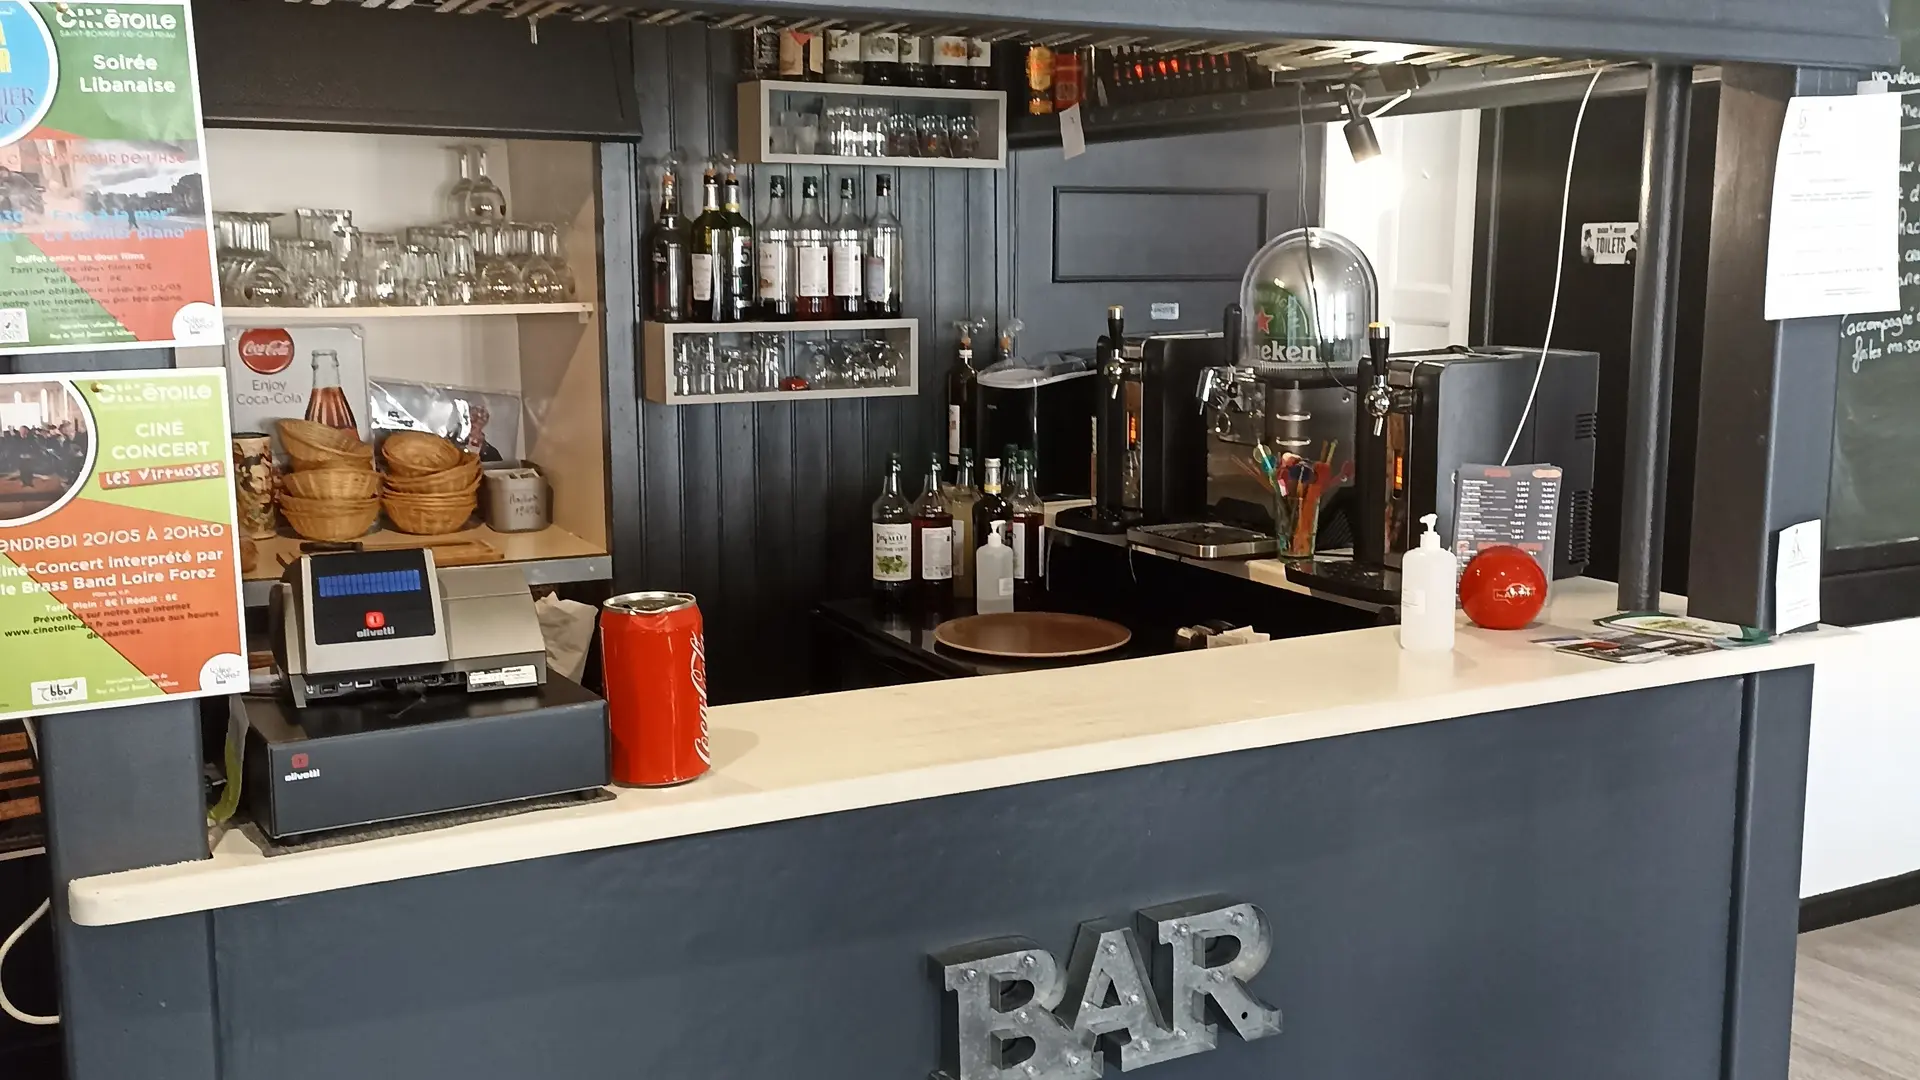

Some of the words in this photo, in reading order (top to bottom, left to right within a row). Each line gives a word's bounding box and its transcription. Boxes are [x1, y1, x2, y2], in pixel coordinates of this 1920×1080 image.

[93, 54, 158, 71] Soirée
[79, 76, 176, 93] Libanaise
[1596, 237, 1626, 254] TOILETS
[252, 379, 287, 392] Enjoy
[236, 392, 303, 406] Coca-Cola
[111, 440, 210, 461] CONCERT
[82, 529, 141, 548] 20/05
[108, 550, 192, 569] interprété
[196, 549, 224, 564] par
[21, 580, 69, 595] Brass
[73, 573, 117, 590] Band
[121, 571, 165, 586] Loire
[168, 568, 217, 582] Forez
[72, 601, 97, 610] Plein
[927, 893, 1283, 1080] BAR
